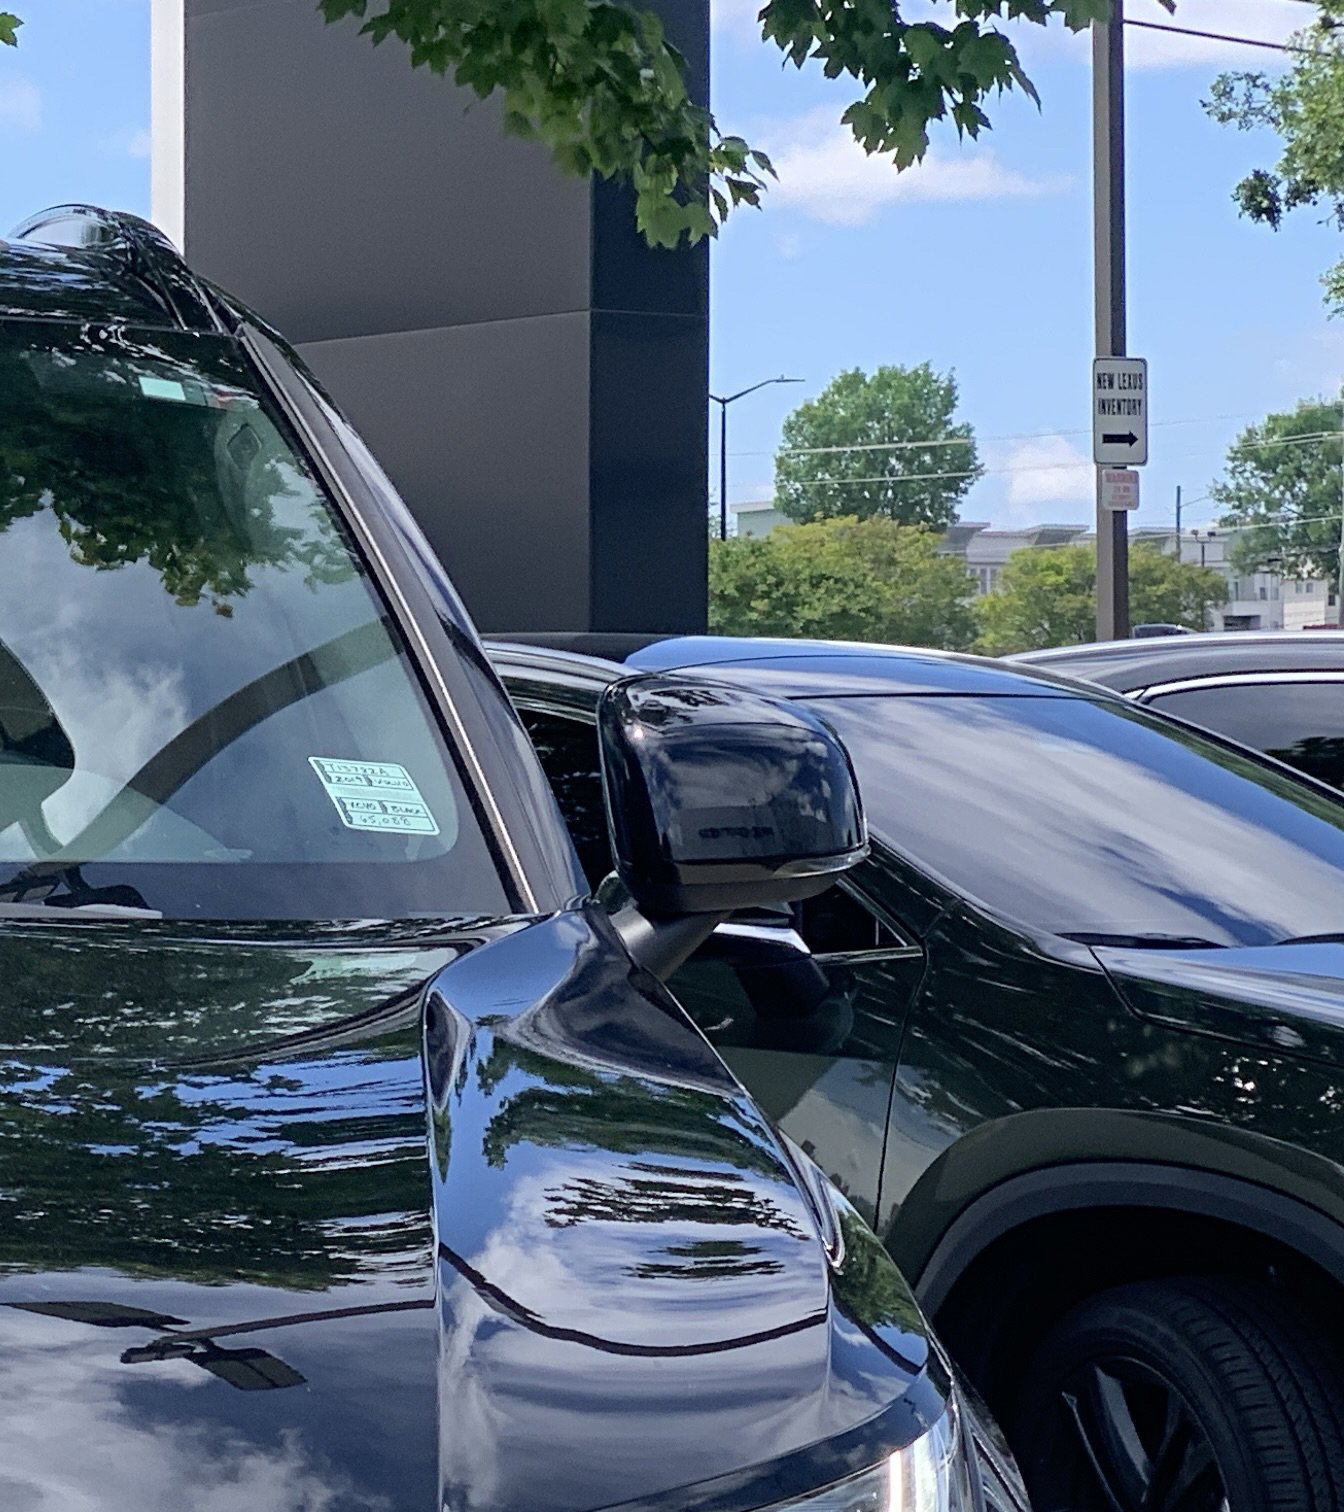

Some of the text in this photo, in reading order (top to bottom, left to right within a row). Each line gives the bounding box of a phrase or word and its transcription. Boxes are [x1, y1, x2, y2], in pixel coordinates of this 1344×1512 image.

[1097, 373, 1142, 389] NEW LEXUS
[1098, 398, 1141, 415] INVENTORY
